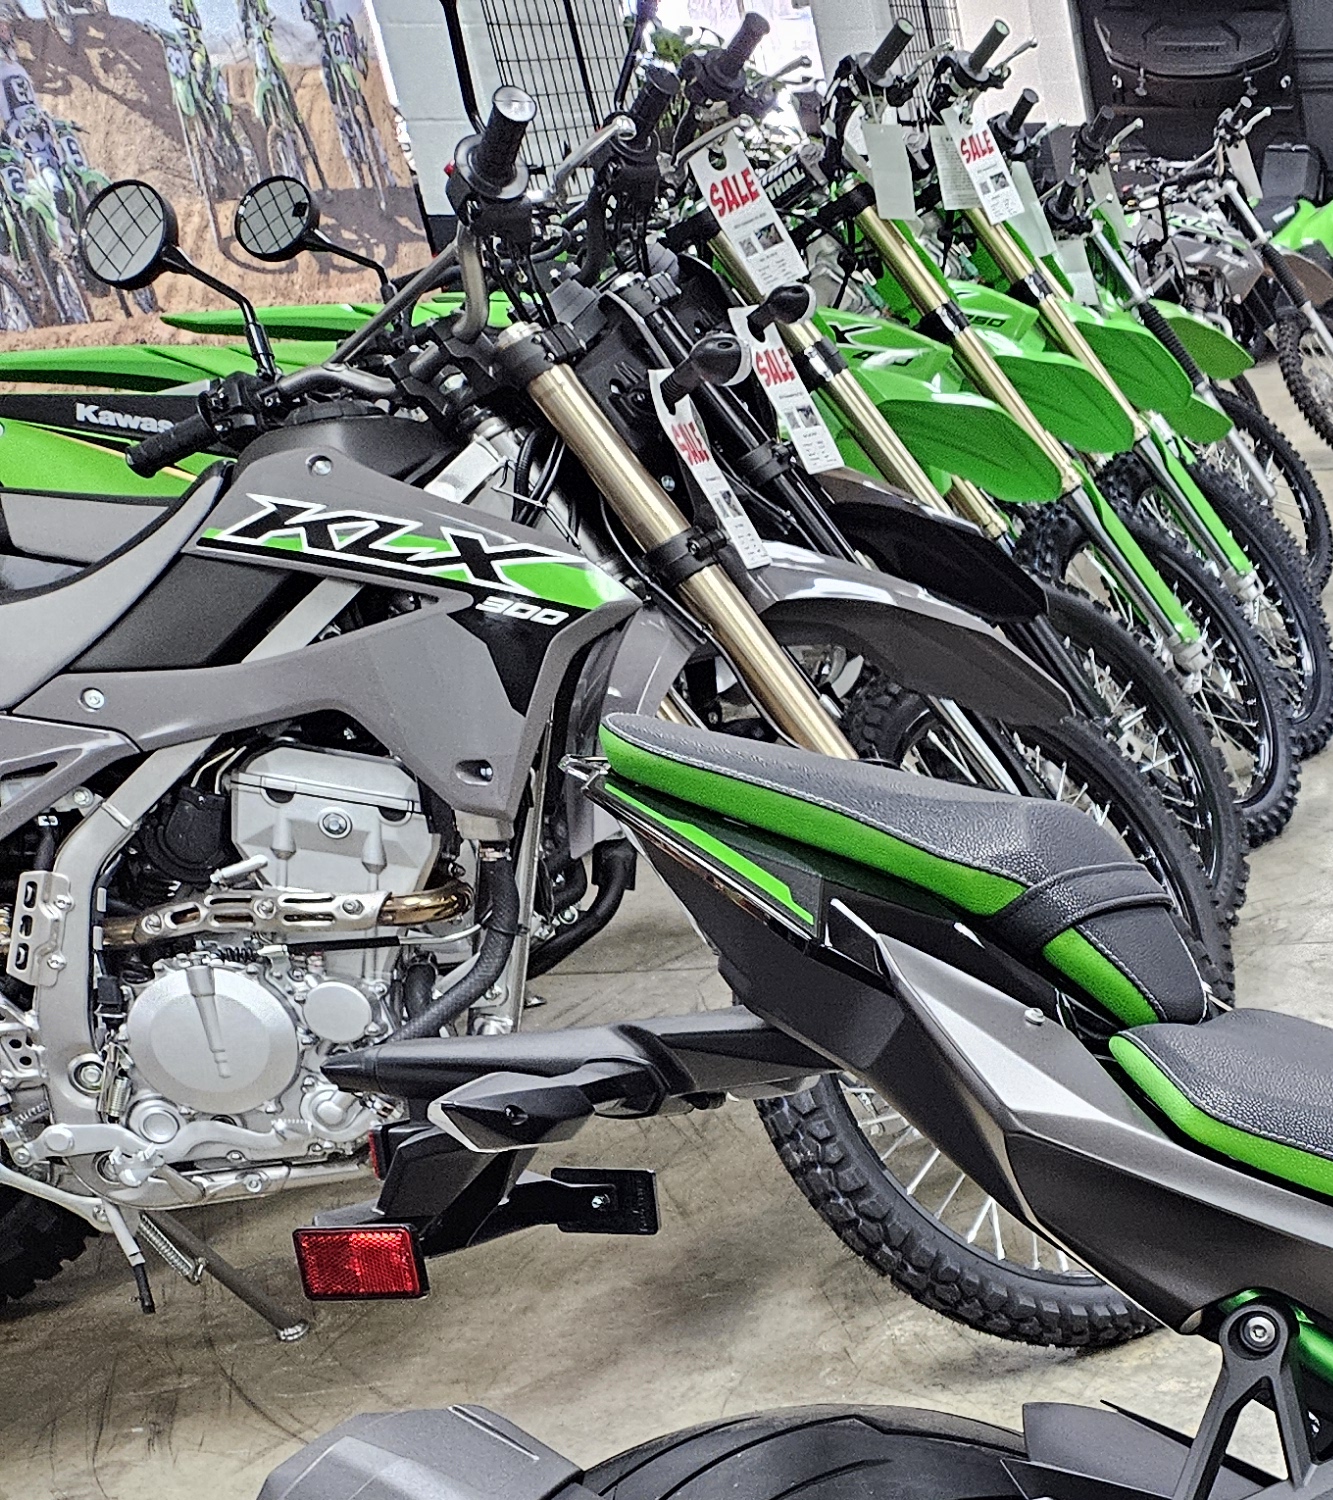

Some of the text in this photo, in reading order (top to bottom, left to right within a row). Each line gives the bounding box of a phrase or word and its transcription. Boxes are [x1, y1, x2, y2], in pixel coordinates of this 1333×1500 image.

[960, 130, 995, 164] SALE
[709, 166, 761, 218] SALE
[765, 165, 806, 201] THAL
[755, 346, 796, 388] SALE
[75, 402, 175, 434] Kawas
[671, 422, 710, 466] SALE
[215, 493, 588, 599] KLX
[475, 595, 570, 627] 300
